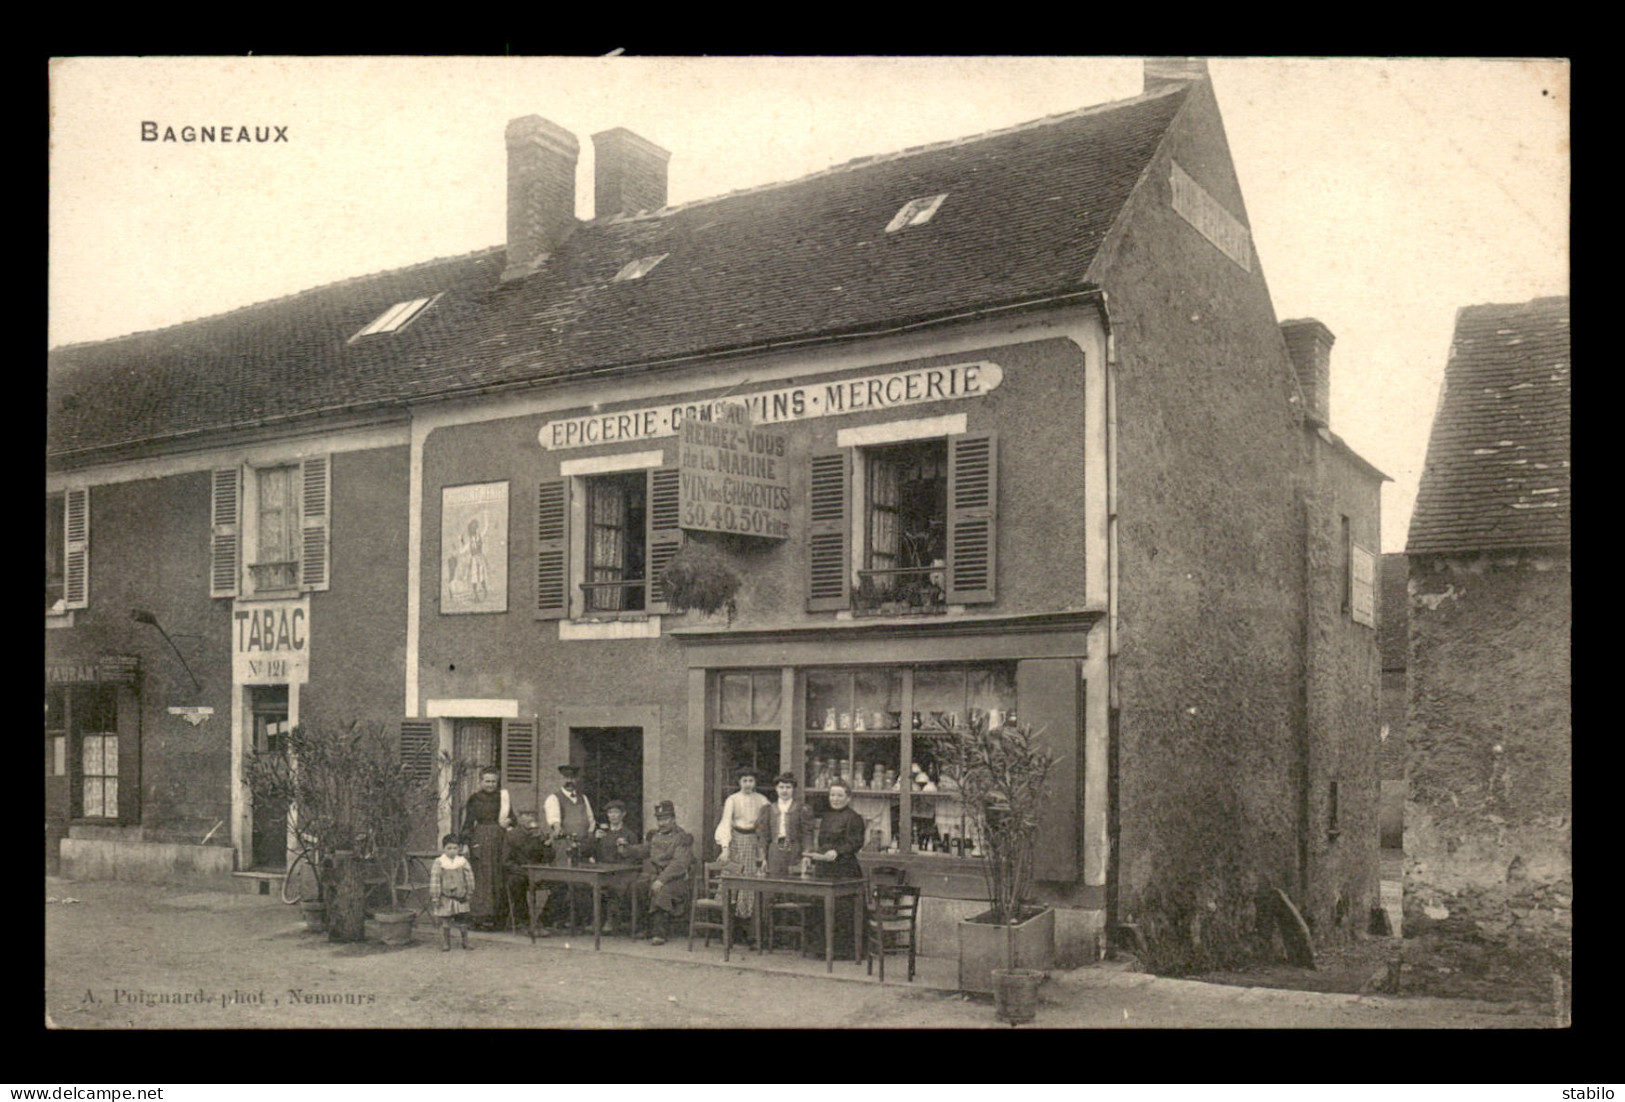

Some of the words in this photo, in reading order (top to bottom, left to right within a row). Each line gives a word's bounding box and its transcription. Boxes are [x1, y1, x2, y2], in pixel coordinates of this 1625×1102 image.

[551, 410, 658, 447] EPICERIE
[824, 365, 981, 413] MERCERIE
[685, 422, 785, 457] RENDEZ-VOUS
[718, 450, 776, 480] MARINE
[682, 473, 708, 502] VIN
[722, 477, 791, 511] CHARENTES
[234, 607, 305, 652] TABAC
